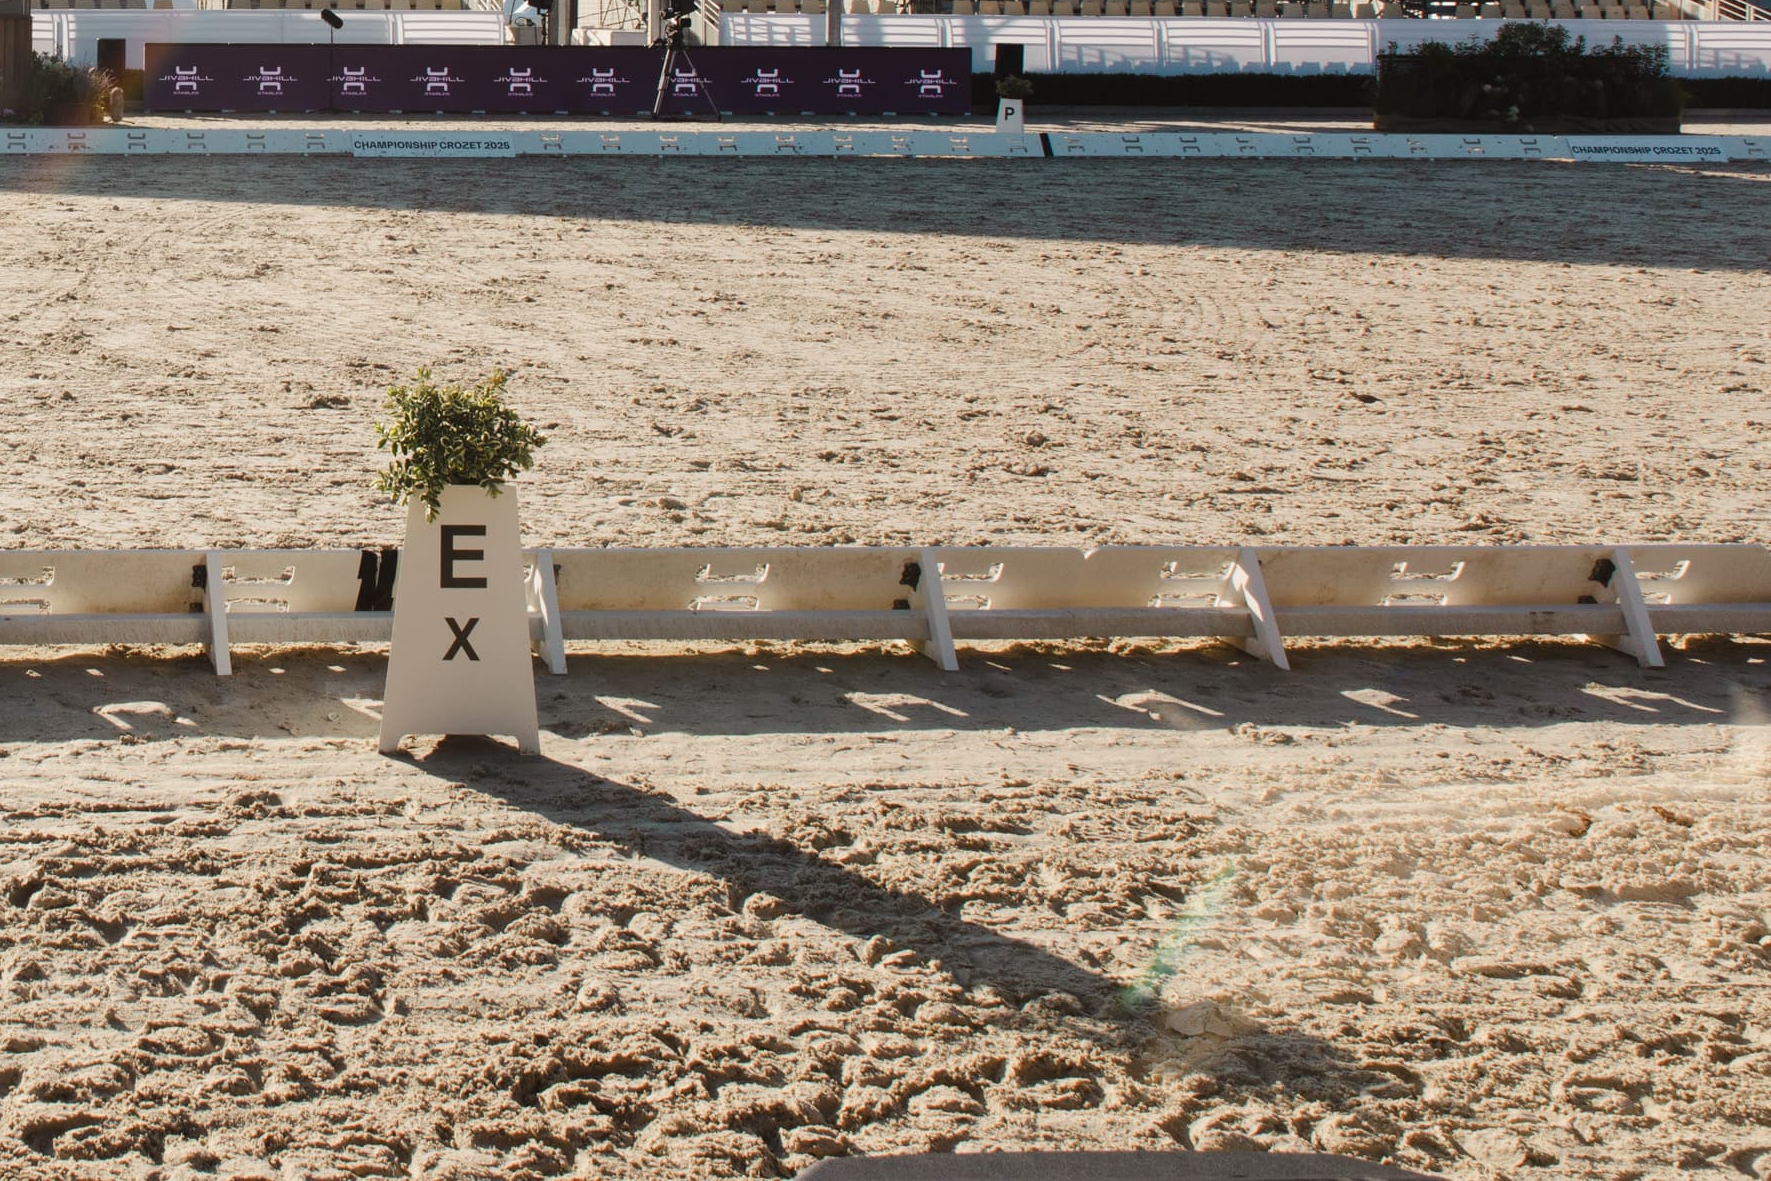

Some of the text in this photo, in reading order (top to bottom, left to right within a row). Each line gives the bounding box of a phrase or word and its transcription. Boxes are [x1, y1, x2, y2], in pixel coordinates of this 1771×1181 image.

[1004, 106, 1015, 120] P
[354, 141, 510, 150] CHAMPIONSHIP CROZET 2025
[1572, 146, 1721, 155] CHAMPIONSHIP CROZET 2025
[440, 525, 487, 589] E
[442, 617, 480, 661] X
